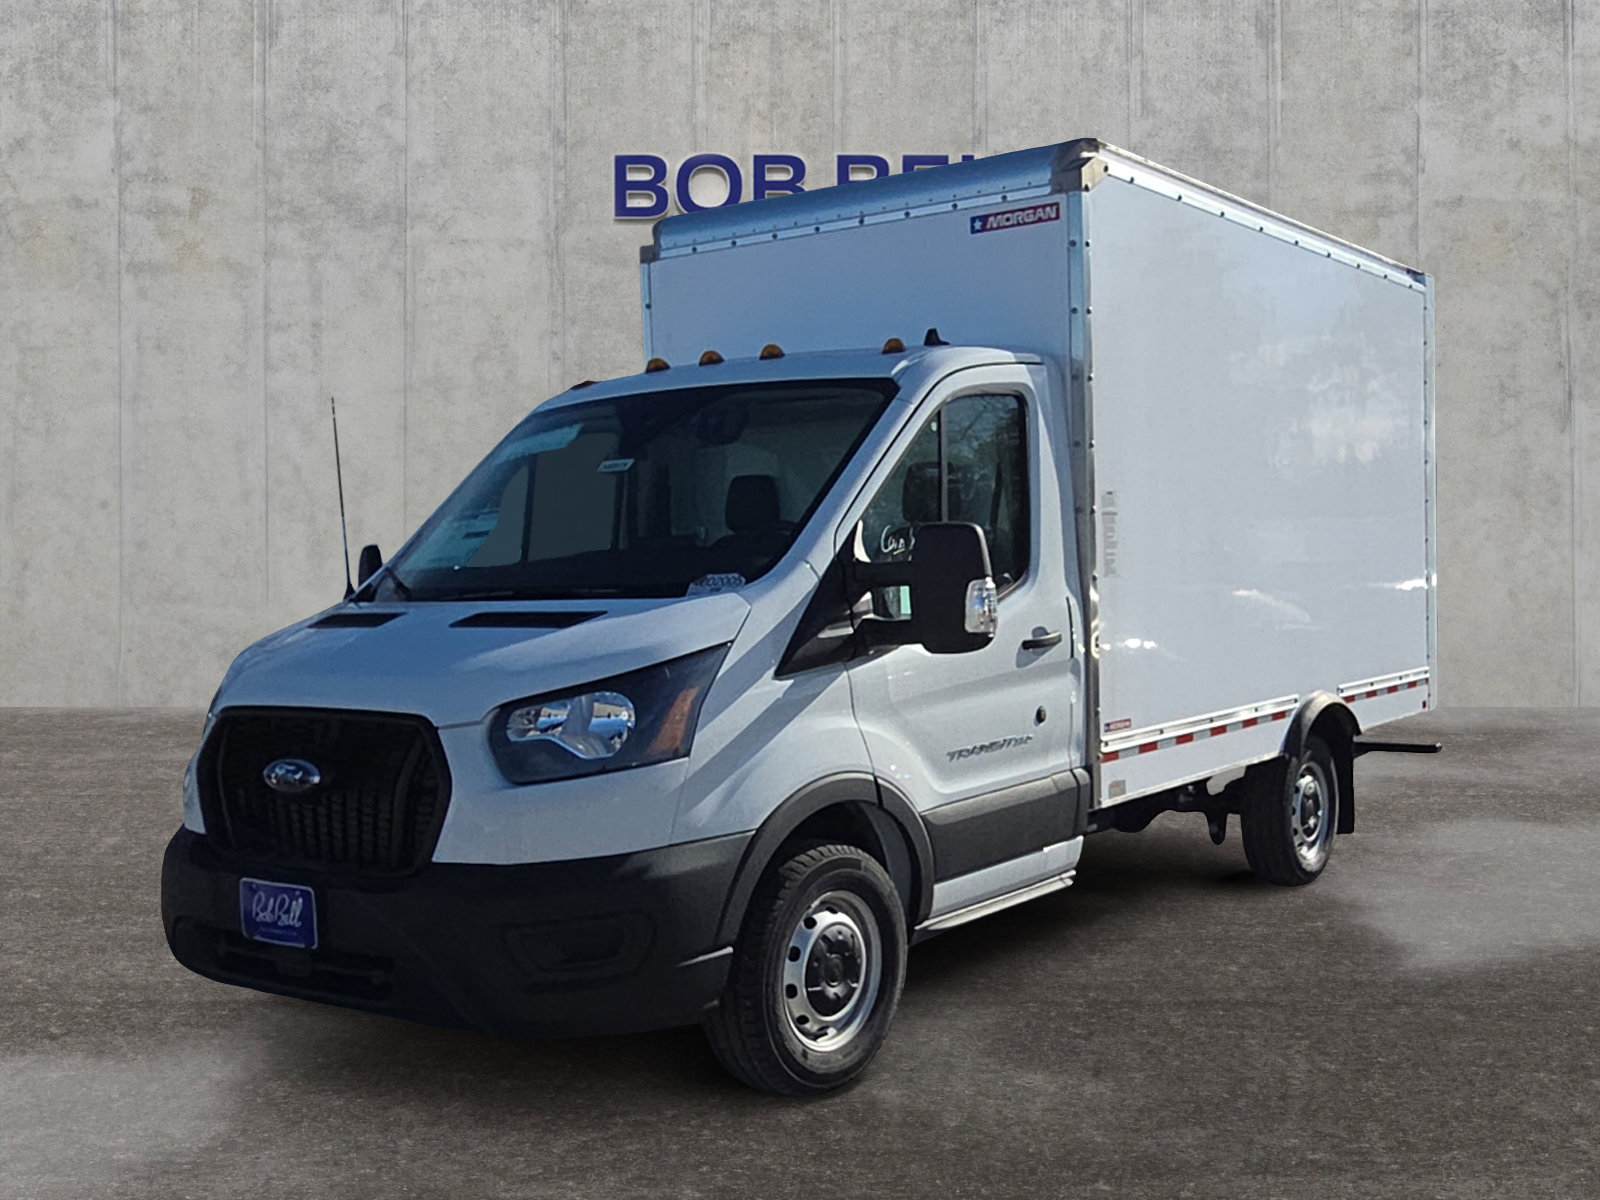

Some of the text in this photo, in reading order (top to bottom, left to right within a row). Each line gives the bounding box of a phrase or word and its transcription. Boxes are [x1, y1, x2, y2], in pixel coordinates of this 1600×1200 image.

[614, 155, 807, 217] BOB
[986, 206, 1057, 229] MORGAN
[946, 737, 1016, 762] TRANSIT
[252, 891, 303, 927] Bob Bell
